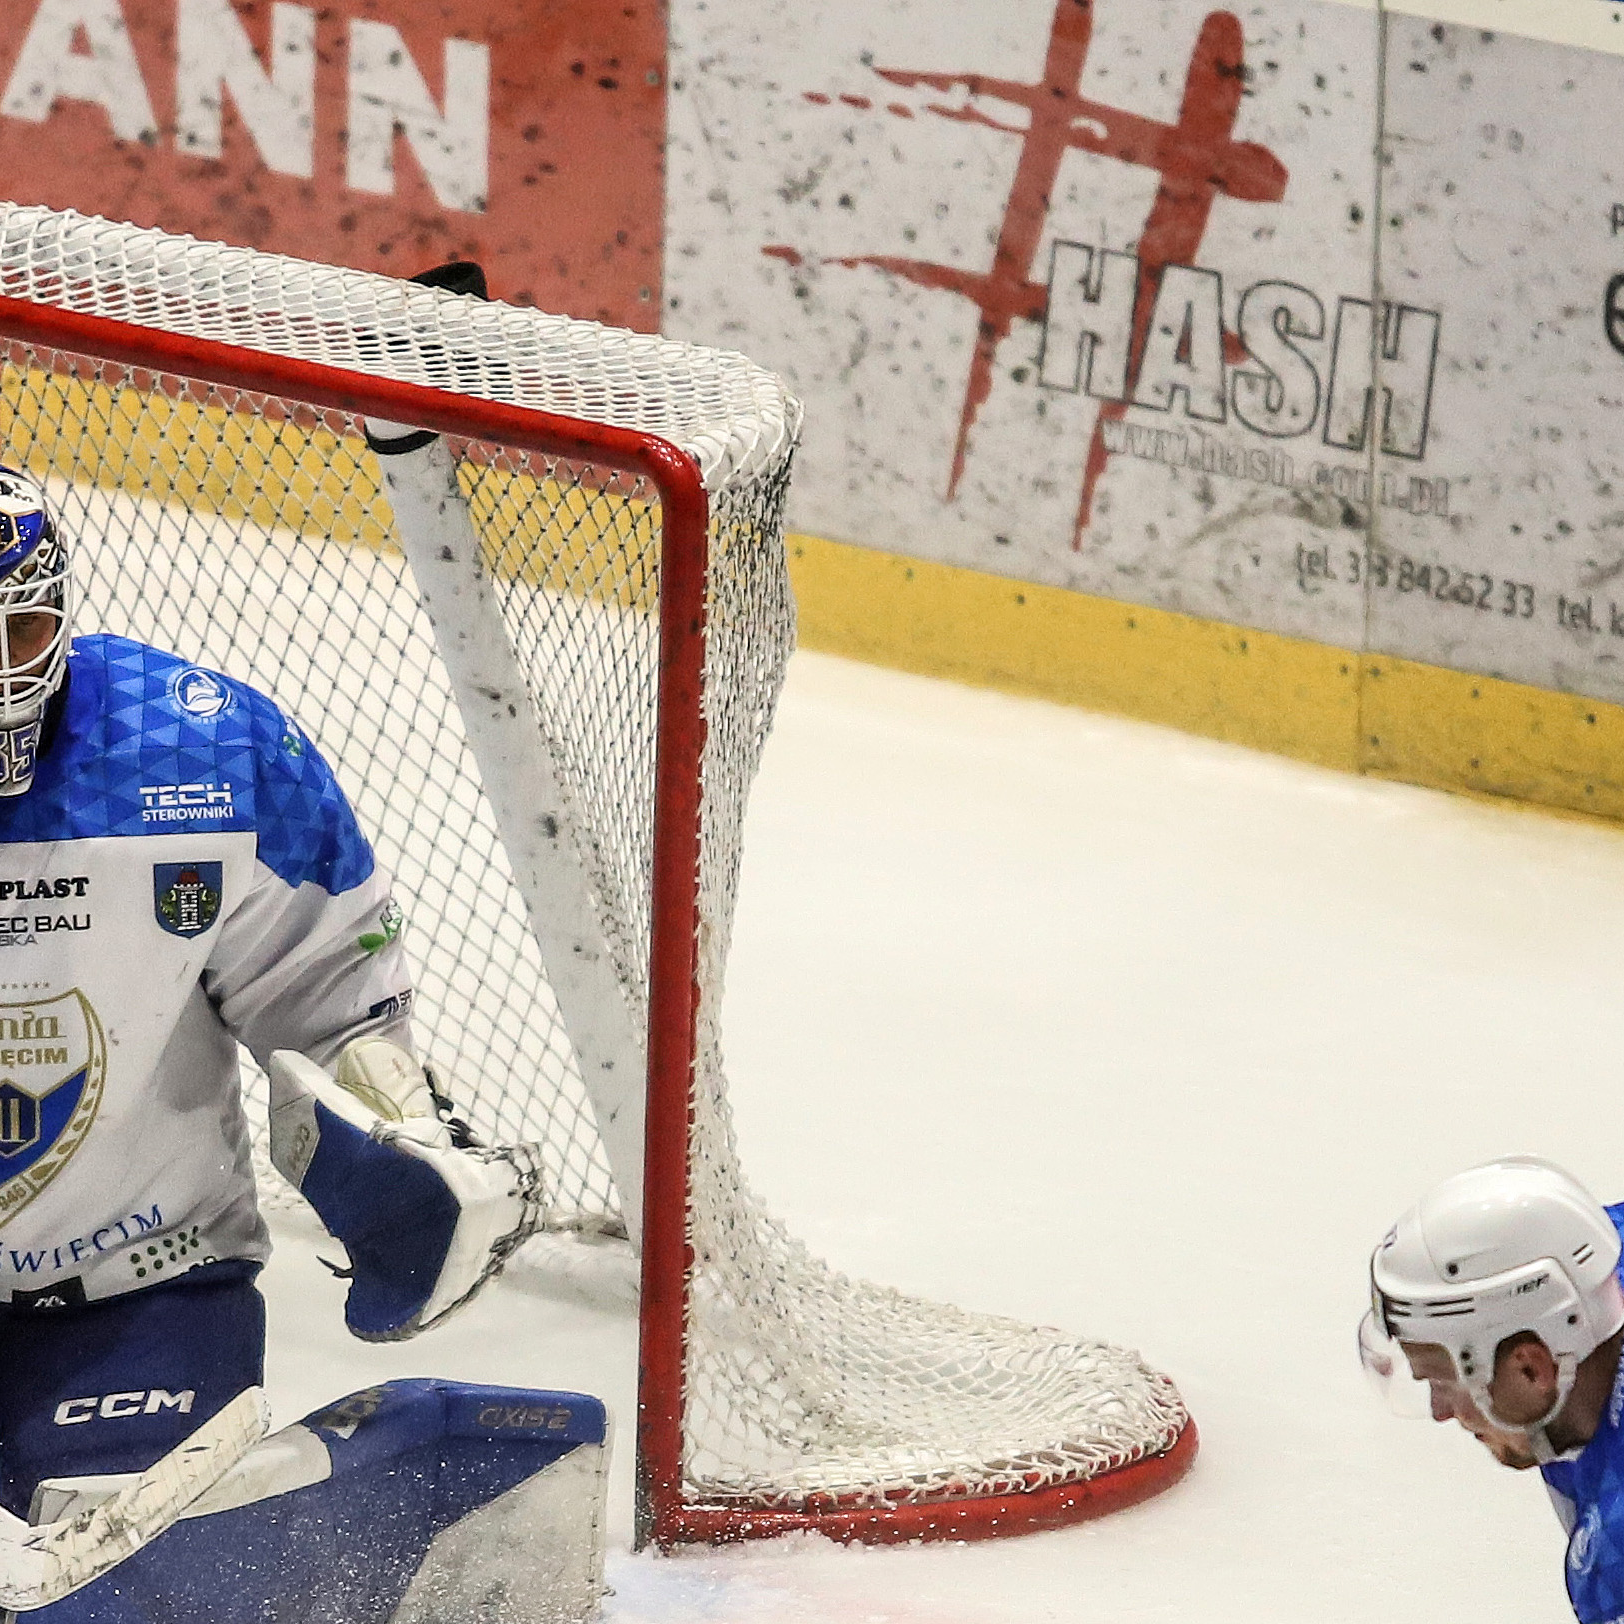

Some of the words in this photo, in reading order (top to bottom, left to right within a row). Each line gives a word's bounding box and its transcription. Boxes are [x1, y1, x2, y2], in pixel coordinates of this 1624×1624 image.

[1040, 239, 1440, 462] HASH
[139, 782, 233, 807] TECH
[142, 805, 235, 822] STEROWNIKI
[34, 913, 92, 932] BAU
[52, 1389, 195, 1427] CCM
